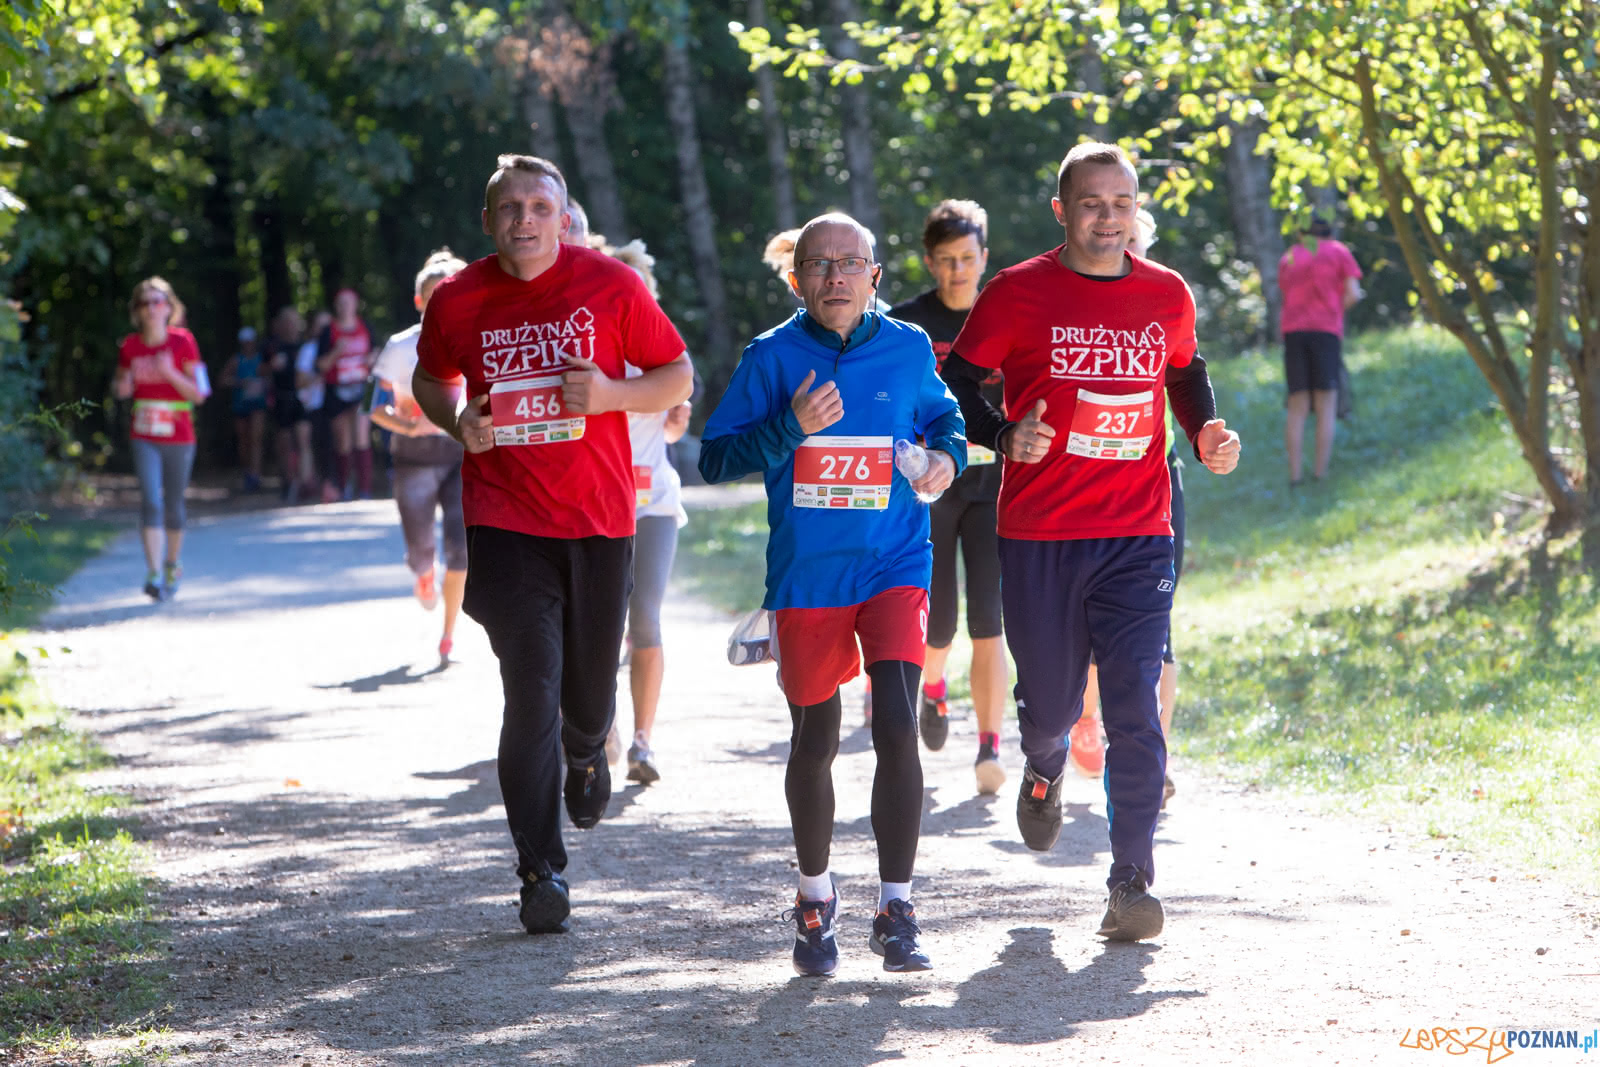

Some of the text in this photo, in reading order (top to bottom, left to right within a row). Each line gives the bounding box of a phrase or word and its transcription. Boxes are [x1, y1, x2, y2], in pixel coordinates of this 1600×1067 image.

[481, 320, 576, 348] DRUŻYNA
[1051, 324, 1152, 348] DRUŻYNA
[482, 336, 596, 378] SZPIKU
[1050, 347, 1167, 377] SZPIKU
[515, 393, 561, 419] 456
[1094, 411, 1140, 434] 237
[819, 455, 870, 480] 276
